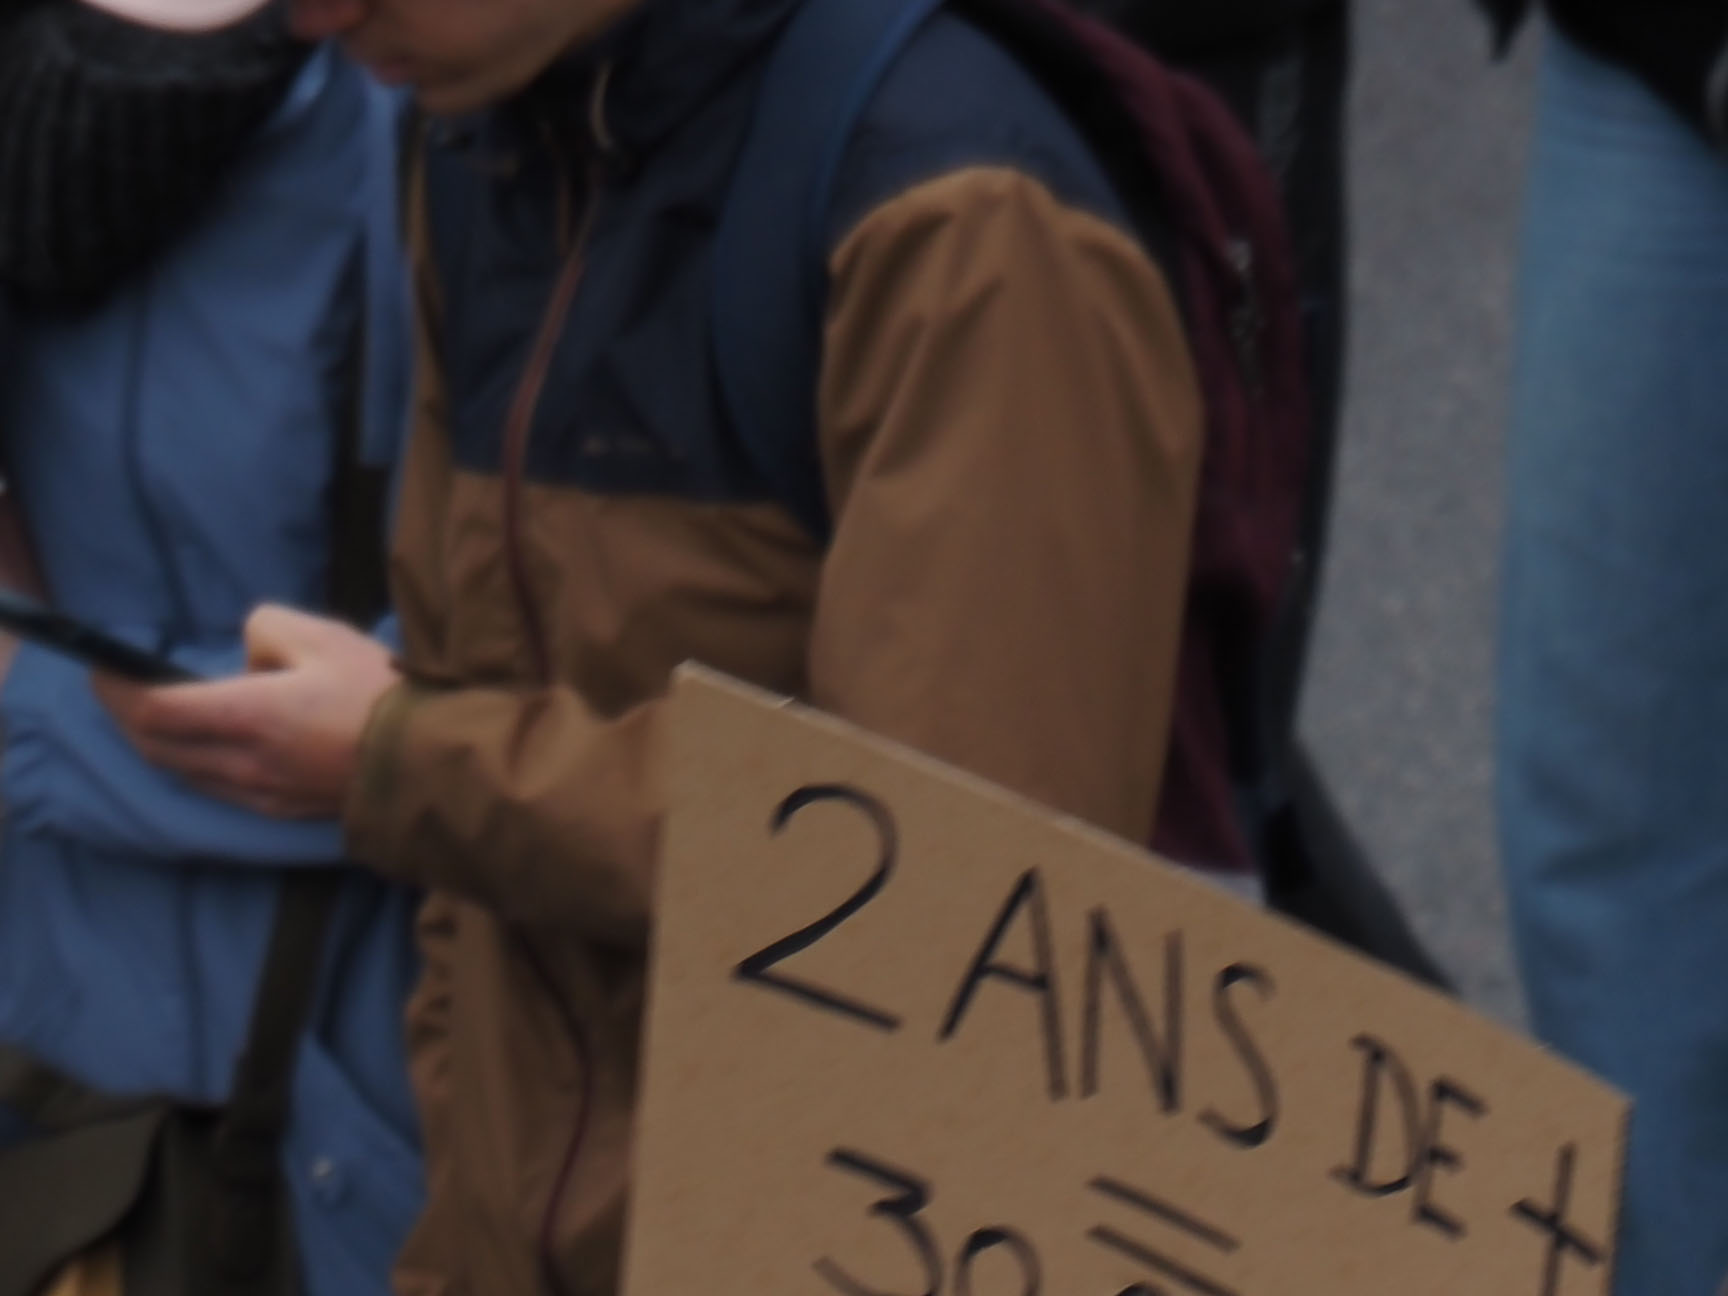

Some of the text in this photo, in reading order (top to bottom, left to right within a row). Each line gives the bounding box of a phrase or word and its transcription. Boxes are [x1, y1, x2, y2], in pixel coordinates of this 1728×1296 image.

[730, 783, 902, 1032] 2
[936, 864, 1278, 1150] ANS
[1330, 1032, 1488, 1240] DE
